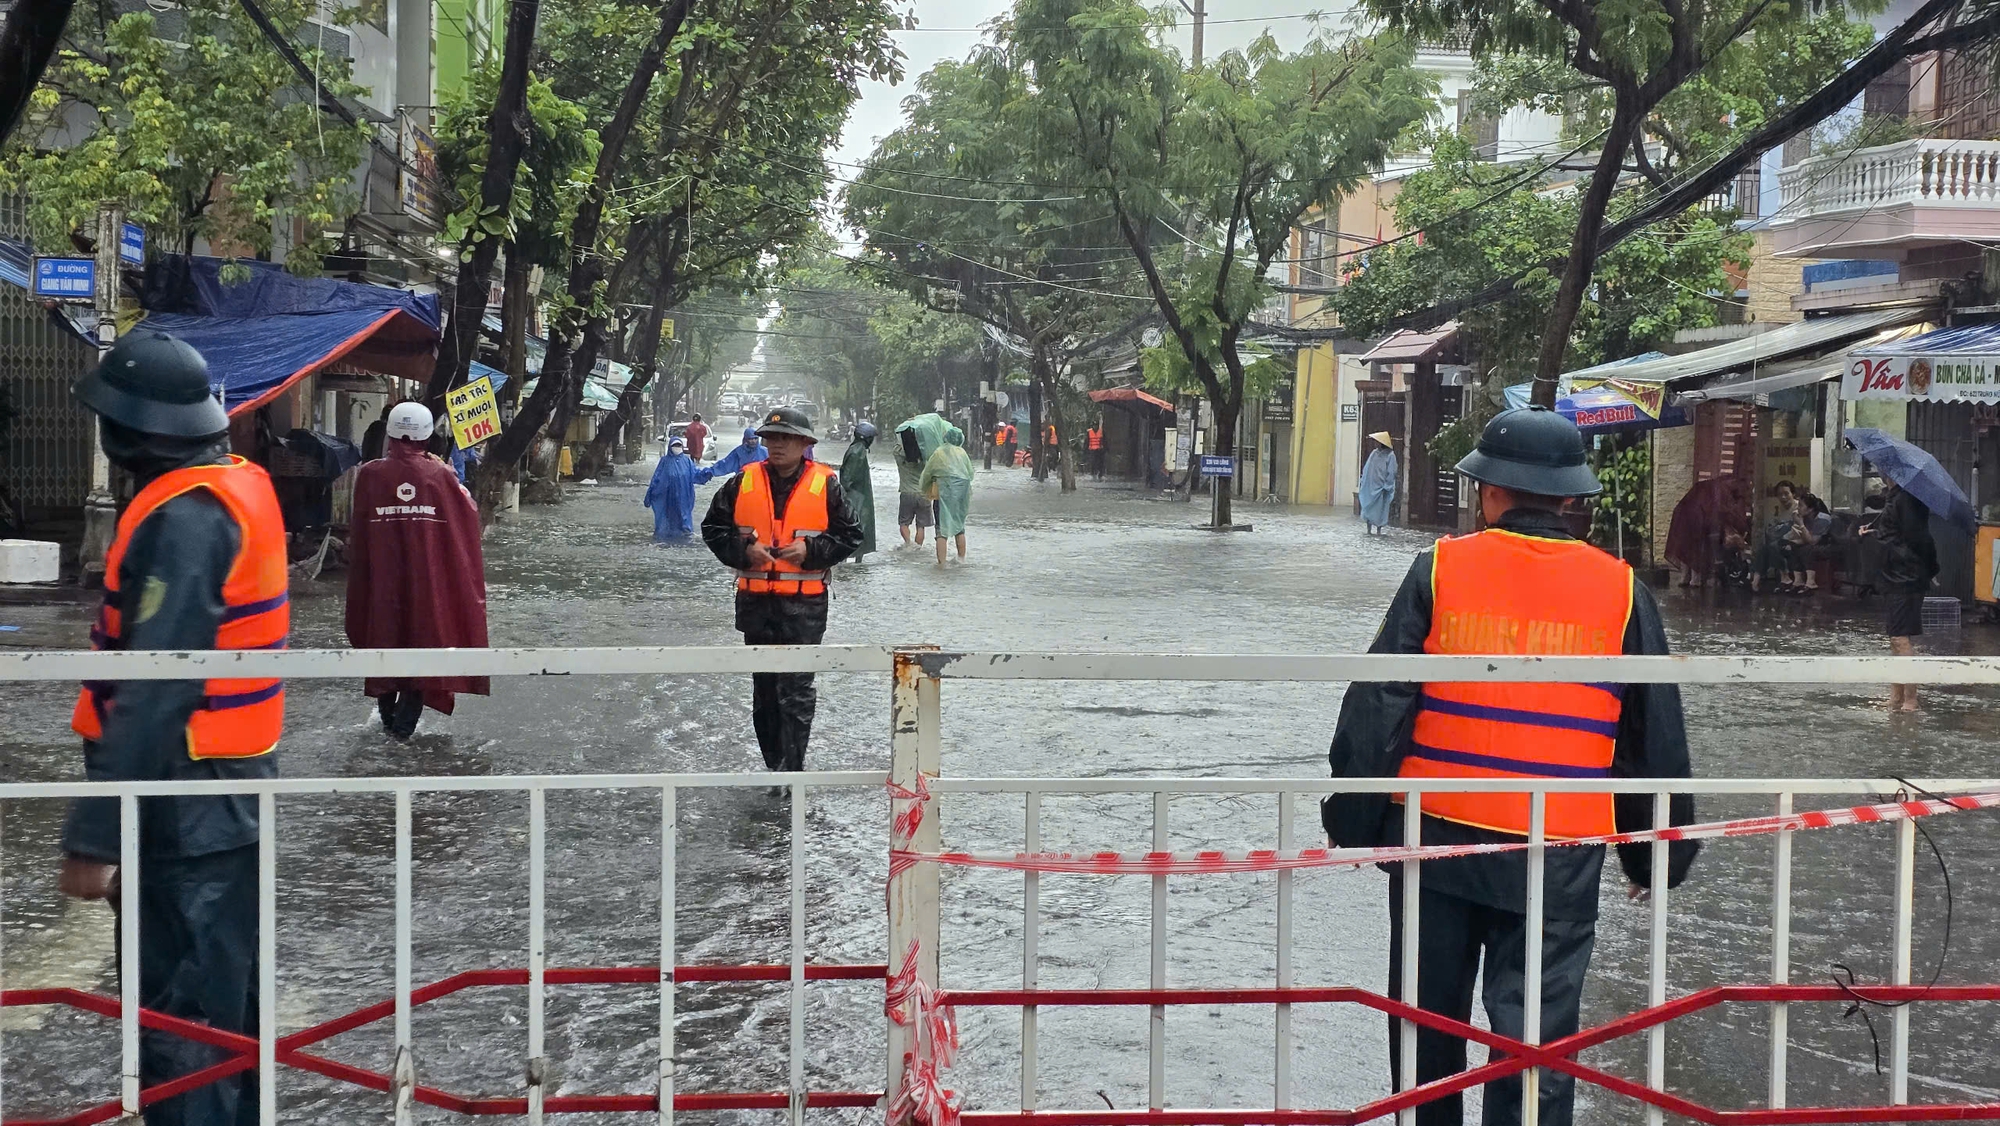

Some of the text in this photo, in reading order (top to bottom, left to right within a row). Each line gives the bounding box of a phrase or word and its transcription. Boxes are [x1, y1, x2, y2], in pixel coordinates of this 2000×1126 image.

[57, 263, 88, 274] ĐƯỜNG
[41, 276, 89, 292] GIANG VĂN MINH
[1851, 358, 1905, 393] Vân
[1935, 360, 1954, 384] BÚN
[1955, 358, 1973, 384] CHẢ
[1974, 360, 1986, 384] CÁ
[1576, 405, 1636, 426] Red Bull
[464, 417, 494, 444] 10K
[375, 505, 437, 516] VIETBANK
